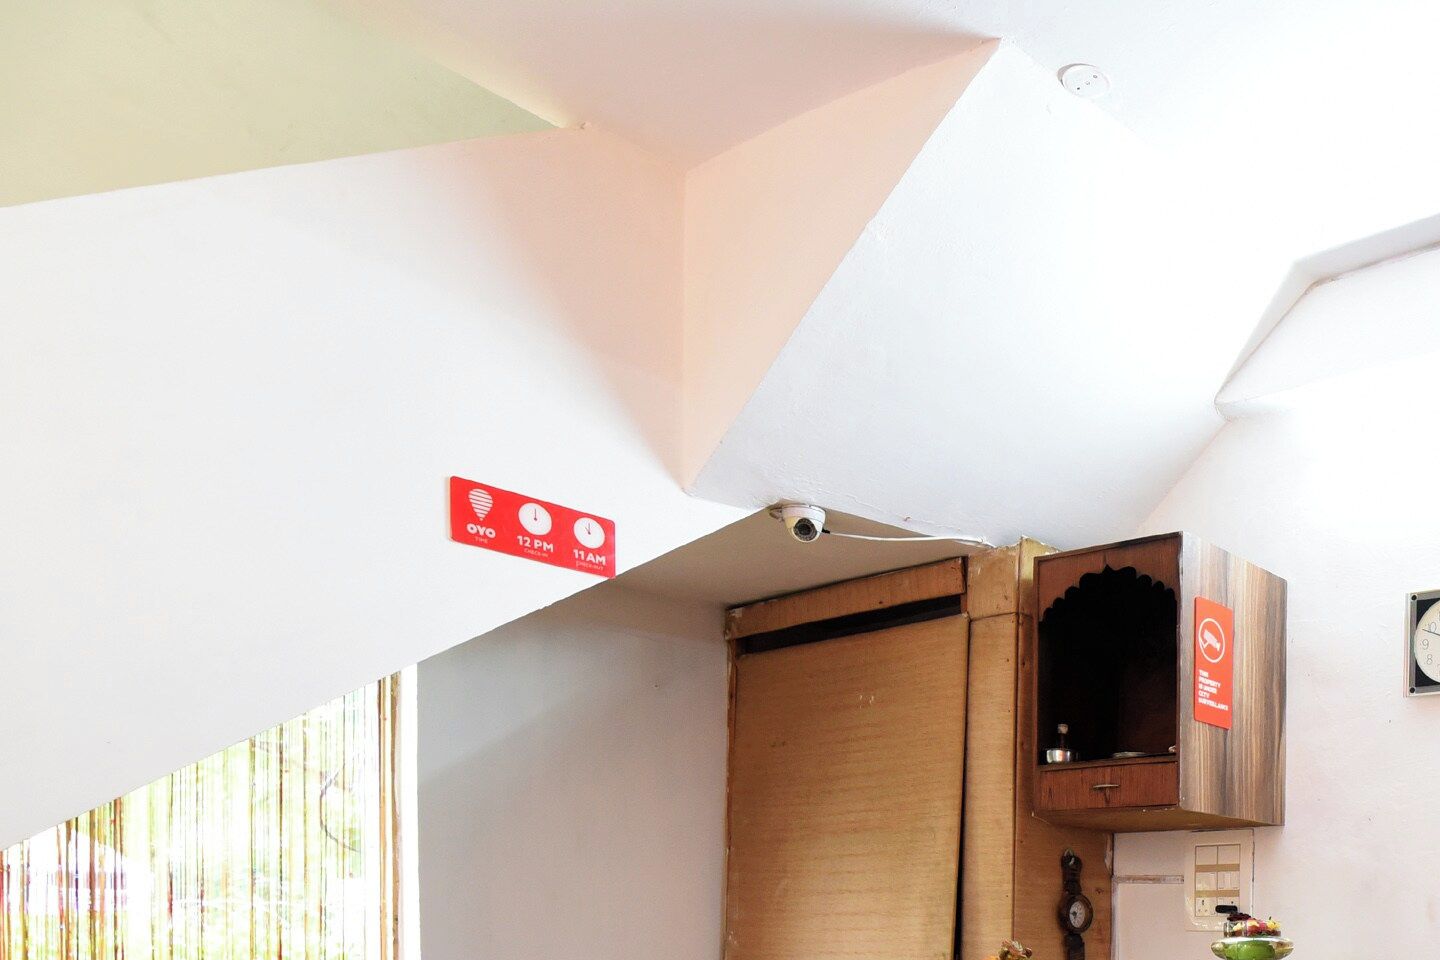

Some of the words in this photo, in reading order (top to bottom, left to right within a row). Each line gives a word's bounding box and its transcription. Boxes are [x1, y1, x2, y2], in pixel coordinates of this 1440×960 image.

[466, 523, 496, 539] OYO
[516, 535, 531, 548] 12
[534, 540, 554, 553] PM
[1422, 639, 1430, 650] 9
[1426, 654, 1433, 665] 8
